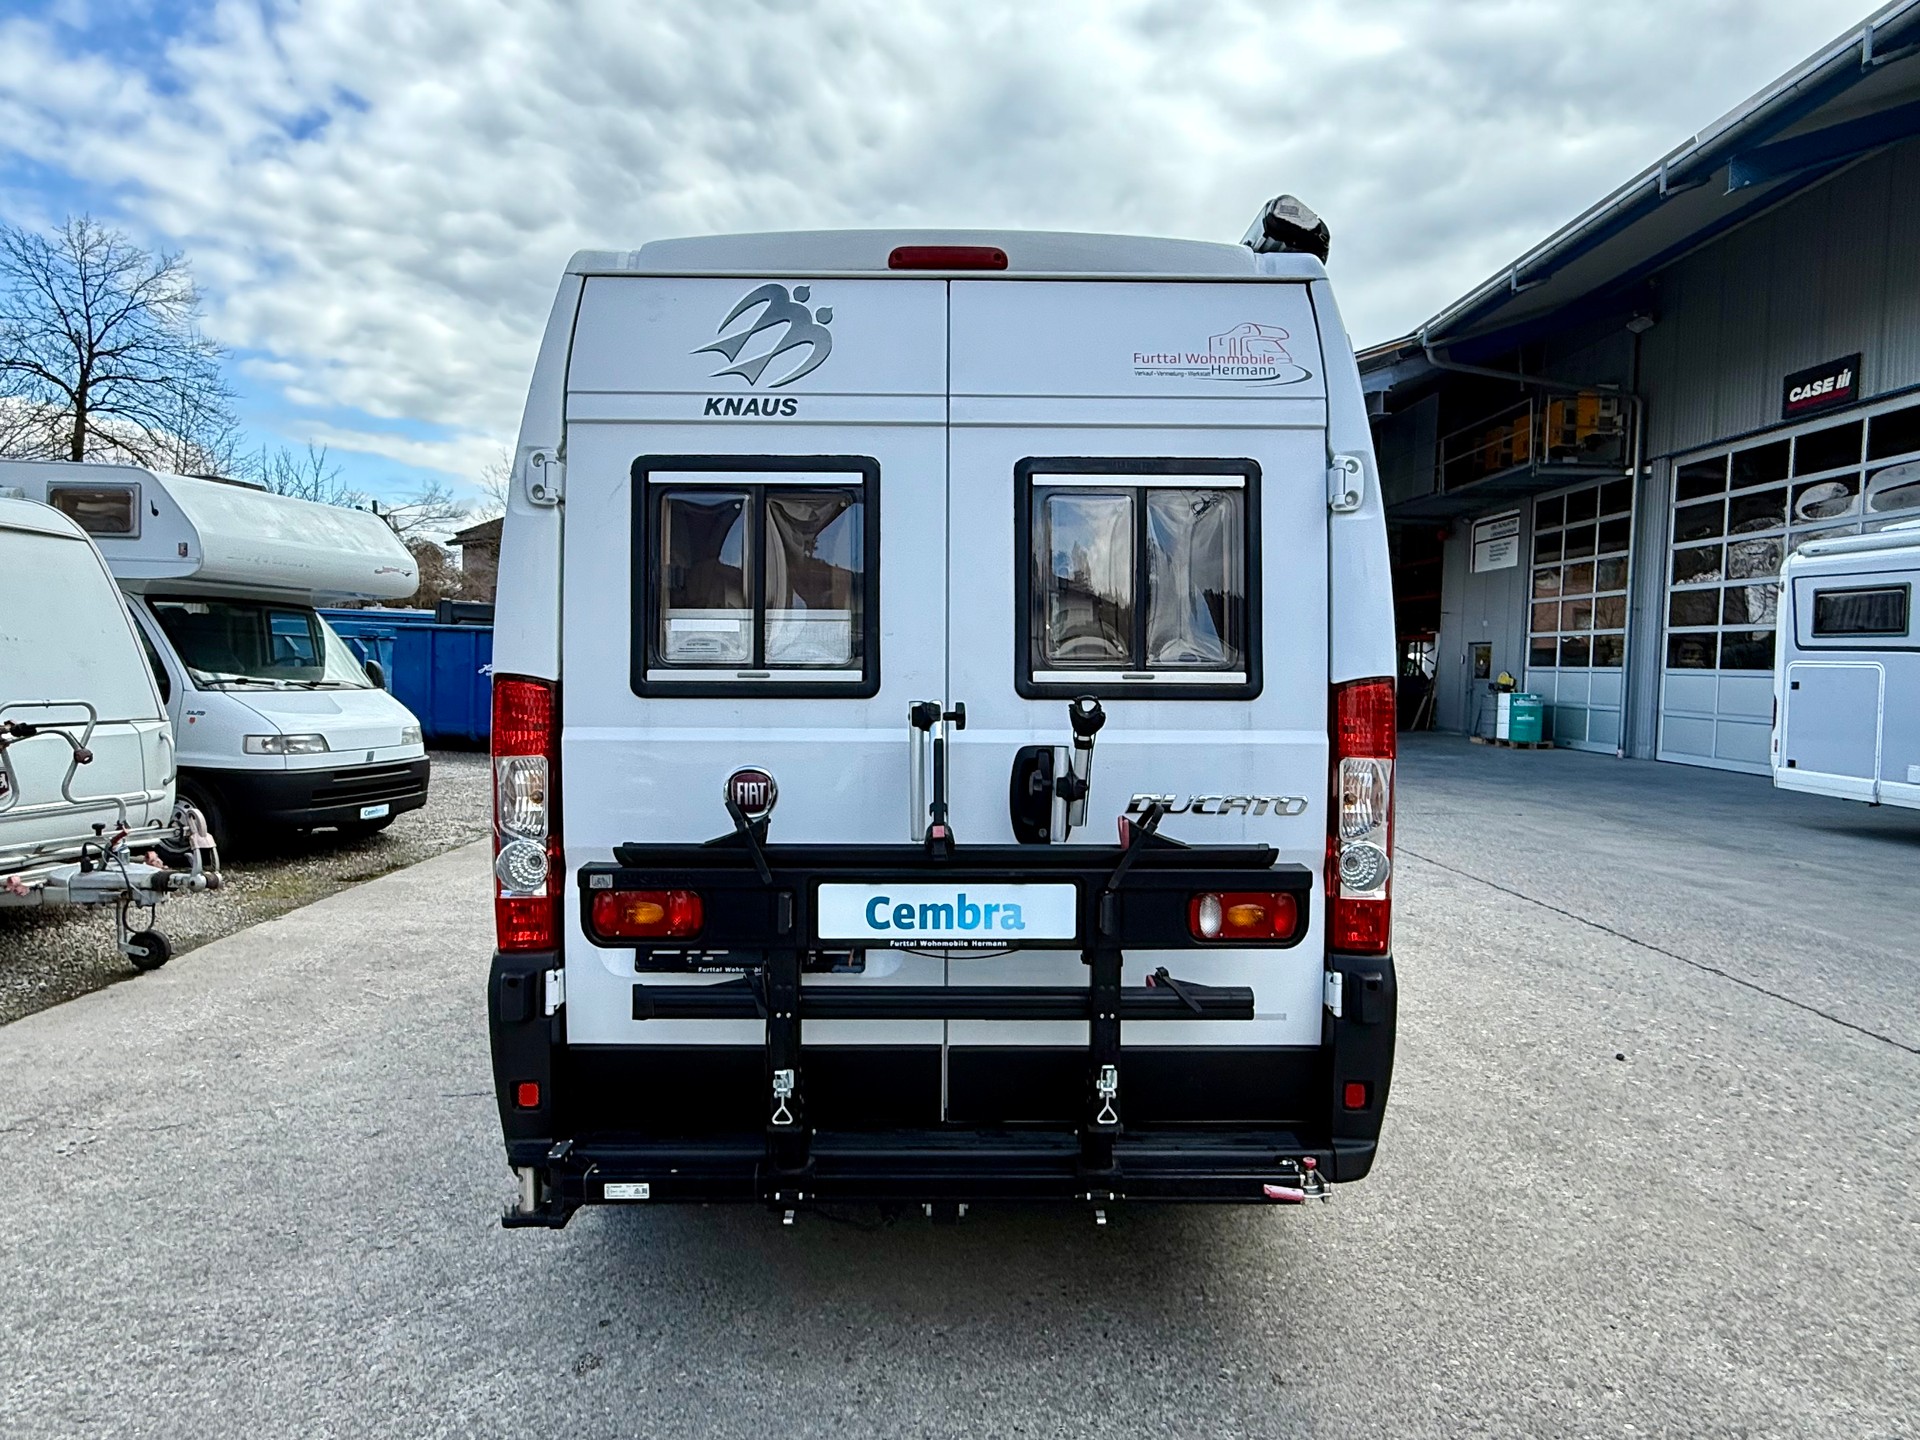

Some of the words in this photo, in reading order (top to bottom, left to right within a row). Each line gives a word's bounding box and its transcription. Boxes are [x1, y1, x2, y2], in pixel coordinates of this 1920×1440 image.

[1133, 352, 1181, 364] Furttal
[1185, 353, 1275, 365] Wohnmobile
[1211, 365, 1276, 375] Hermann
[1789, 376, 1835, 402] CASE
[703, 398, 798, 416] KNAUS
[736, 782, 767, 805] FIAT
[1125, 793, 1309, 816] DUCATO
[865, 893, 1026, 930] Cembra
[890, 939, 917, 947] Furttal
[920, 939, 968, 947] Wohnmobile
[971, 939, 1007, 947] Hermann
